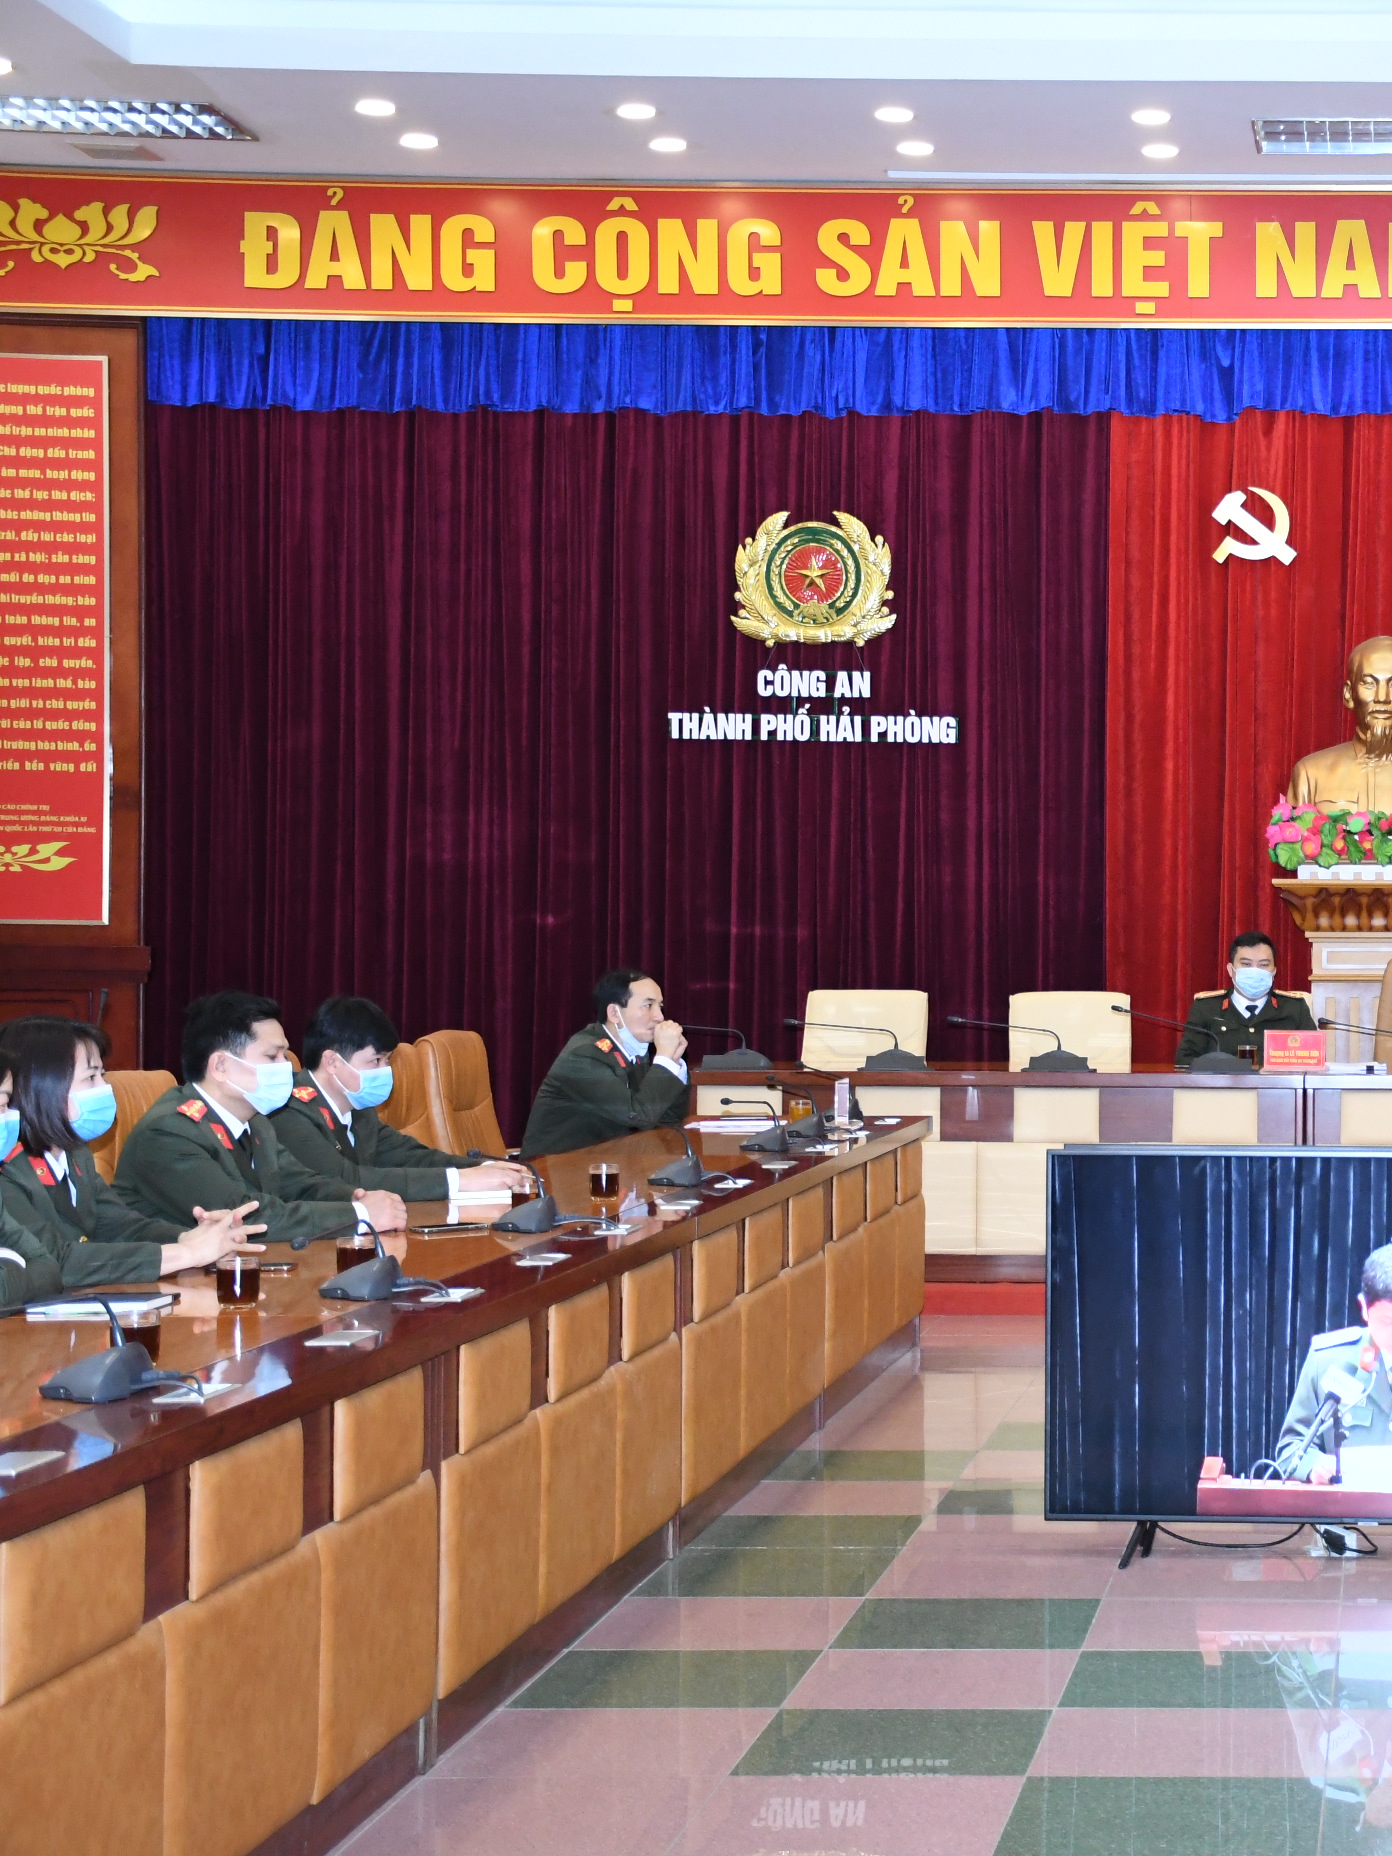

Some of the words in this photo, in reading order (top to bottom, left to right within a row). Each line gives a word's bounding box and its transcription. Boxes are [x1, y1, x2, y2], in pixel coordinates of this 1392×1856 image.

[240, 188, 495, 291] ĐẢNG
[531, 197, 781, 311] CỘNG
[816, 195, 1000, 296] SẢN
[1033, 201, 1223, 314] VIỆT
[69, 449, 95, 459] tranh
[757, 664, 826, 699] CÔNG
[834, 671, 870, 698] AN
[668, 707, 752, 740] THÀNH
[760, 702, 810, 741] PHỐ
[820, 705, 862, 742] HẢI
[871, 710, 958, 743] PHÒNG
